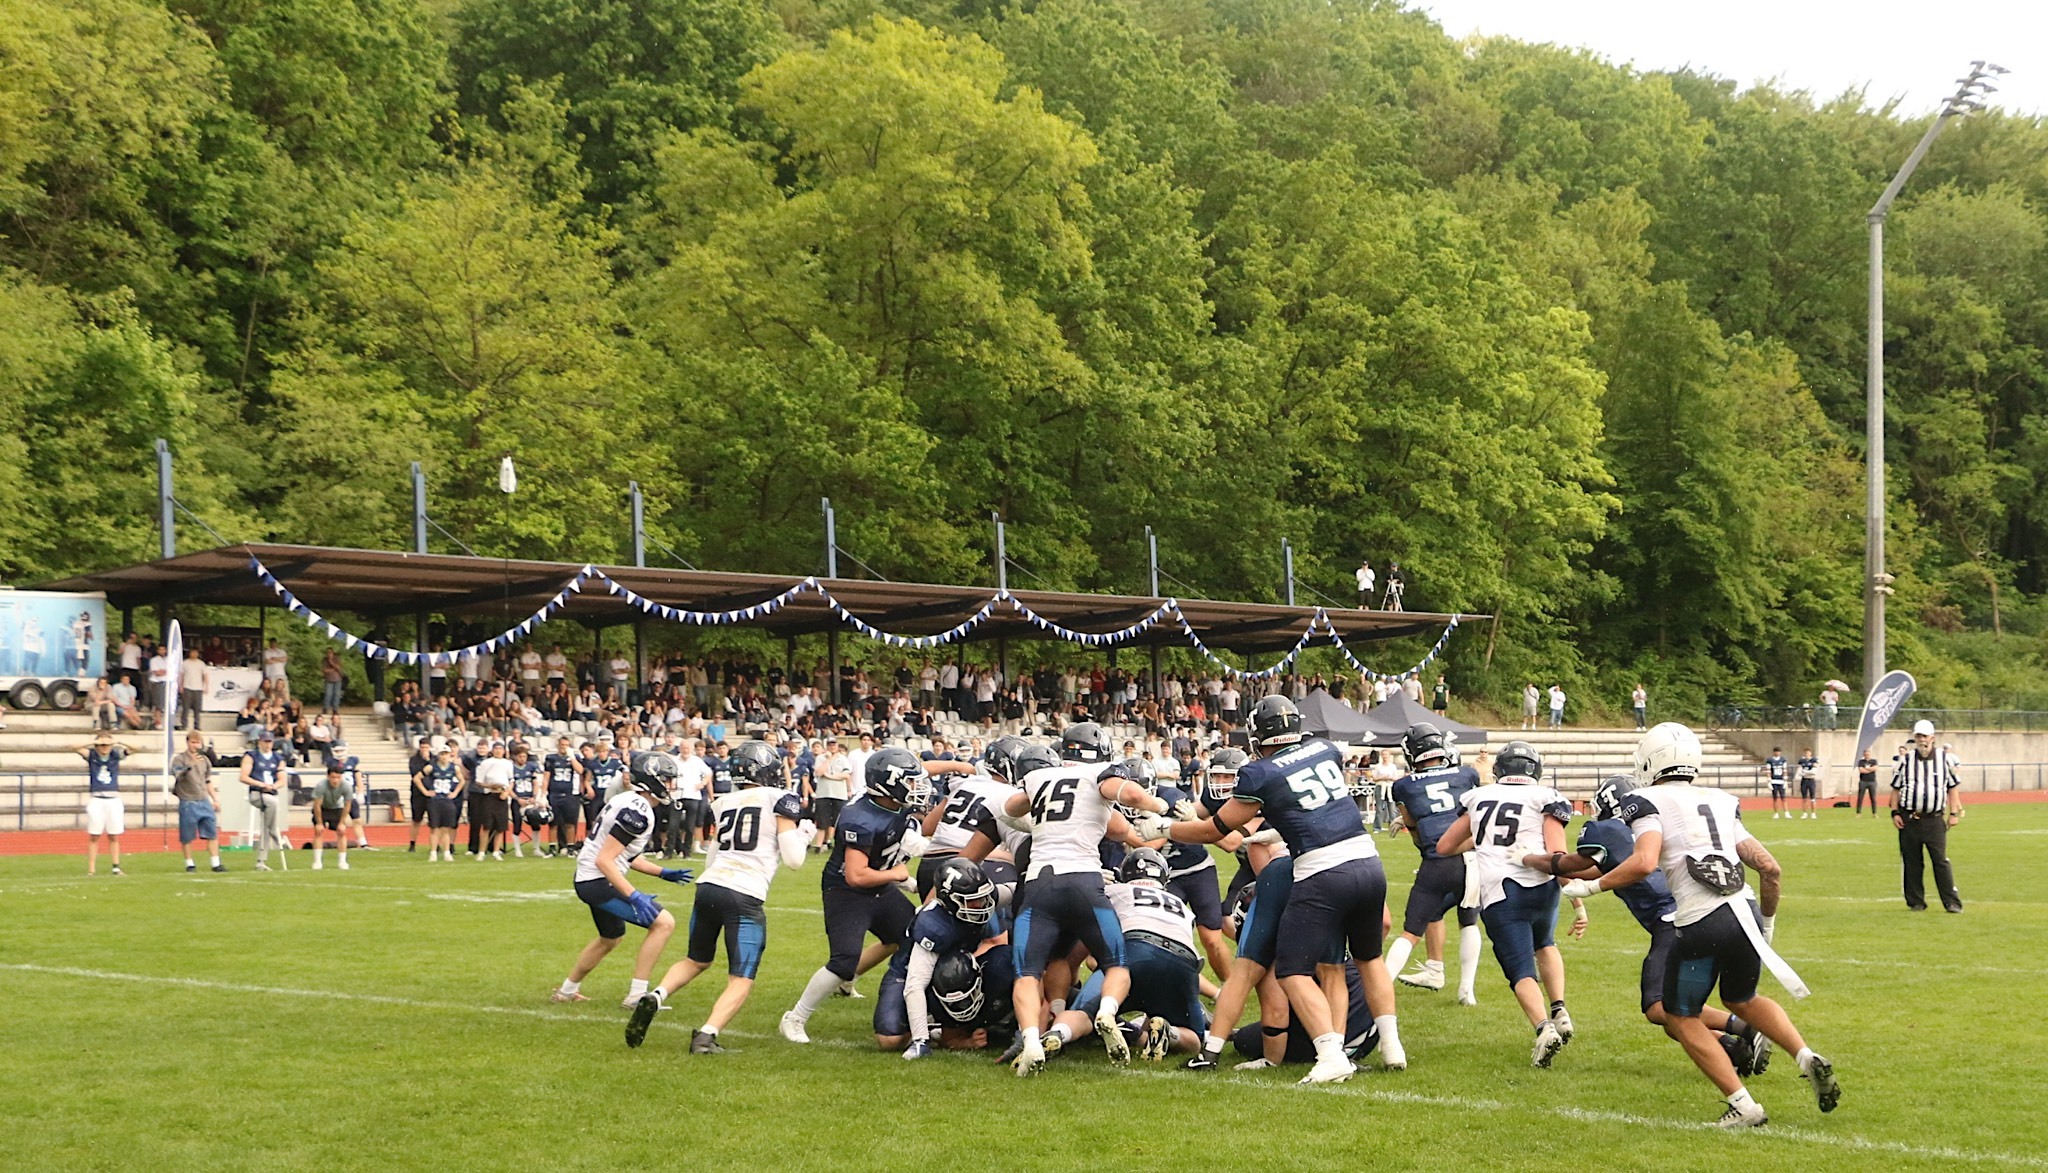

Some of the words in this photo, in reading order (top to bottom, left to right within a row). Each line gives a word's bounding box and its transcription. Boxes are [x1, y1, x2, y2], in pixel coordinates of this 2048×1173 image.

[631, 799, 649, 813] 46
[1030, 778, 1080, 826] 45
[1286, 760, 1349, 810] 59
[1425, 782, 1455, 813] 5
[717, 806, 762, 851] 20
[1475, 800, 1523, 847] 75
[1697, 804, 1723, 851] 1
